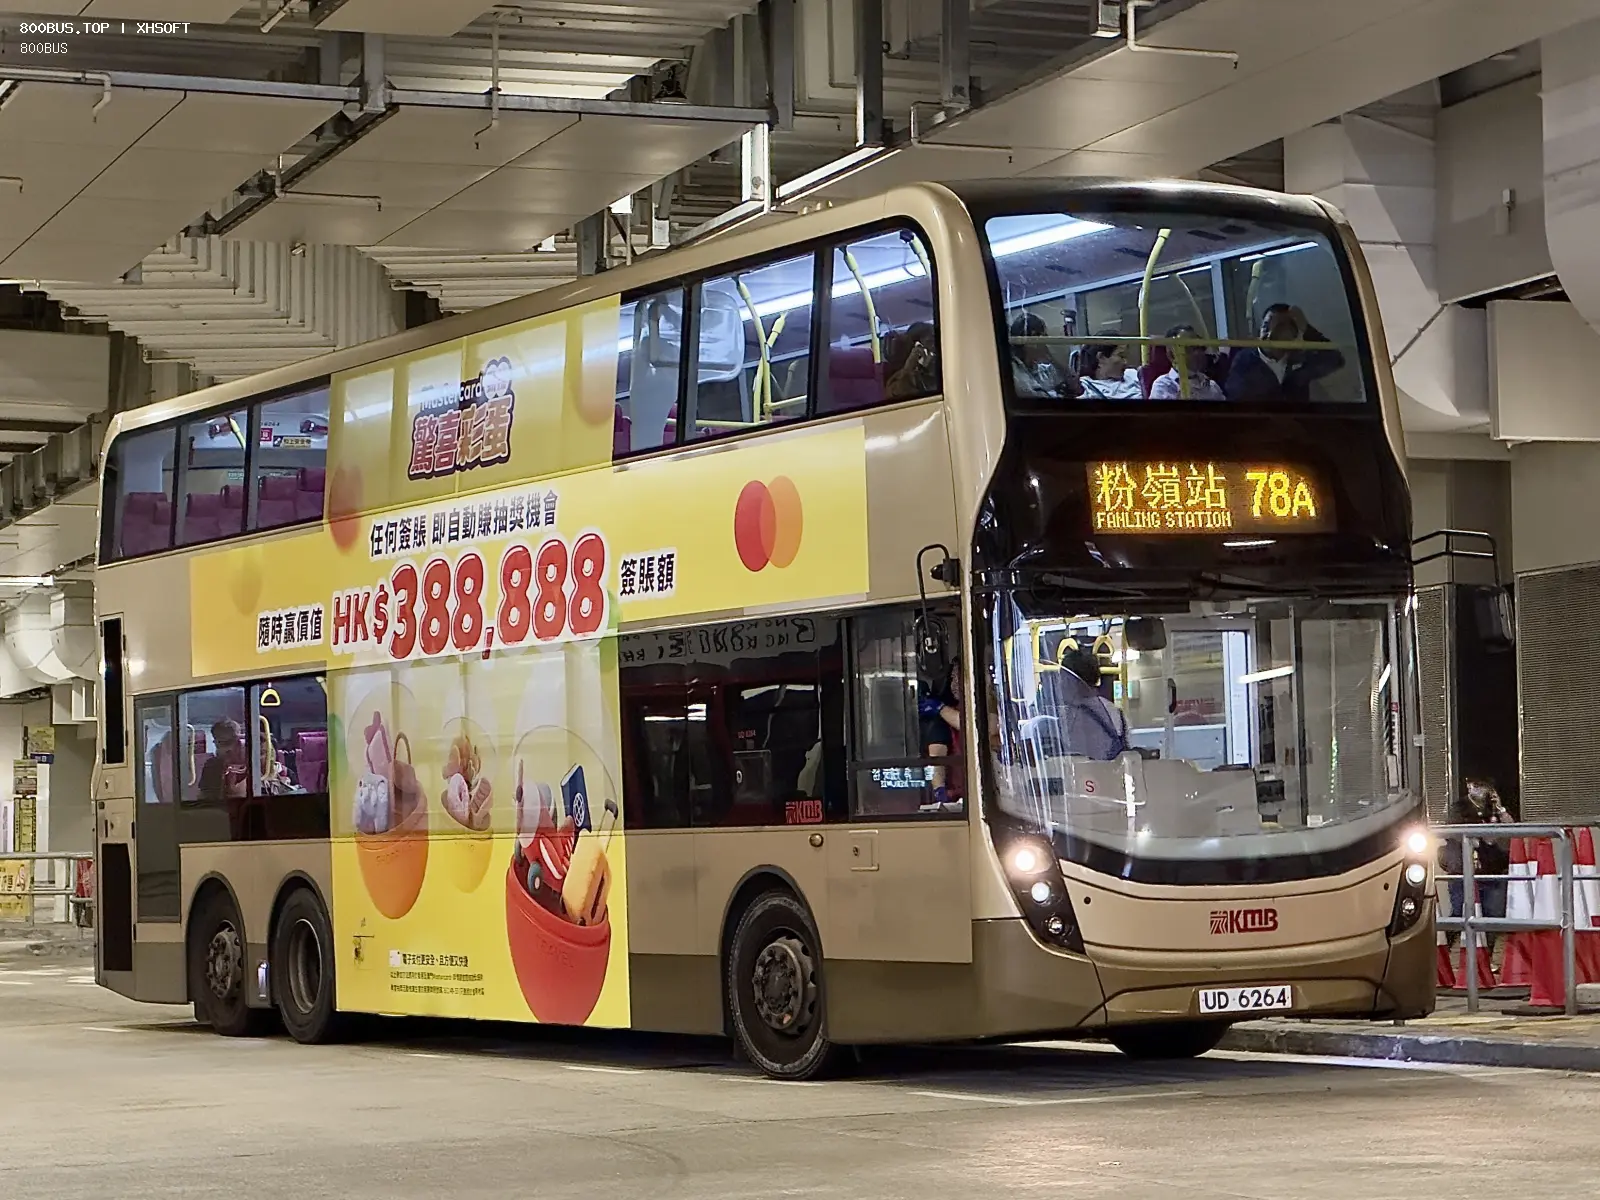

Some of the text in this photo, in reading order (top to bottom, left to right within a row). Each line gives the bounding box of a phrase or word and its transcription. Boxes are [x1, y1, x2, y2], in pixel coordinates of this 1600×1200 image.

[410, 396, 514, 477] 驚喜彩蛋
[1095, 462, 1227, 511] 粉嶺站
[1245, 471, 1317, 517] 78A
[370, 515, 427, 557] 任何簽賬
[1096, 511, 1232, 528] FANLING STATION
[257, 608, 323, 648] 隨時贏價值
[331, 533, 607, 660] HK$388,888
[619, 552, 676, 597] 簽賬額
[1229, 908, 1279, 934] KMB
[1203, 988, 1287, 1010] UD 6264
